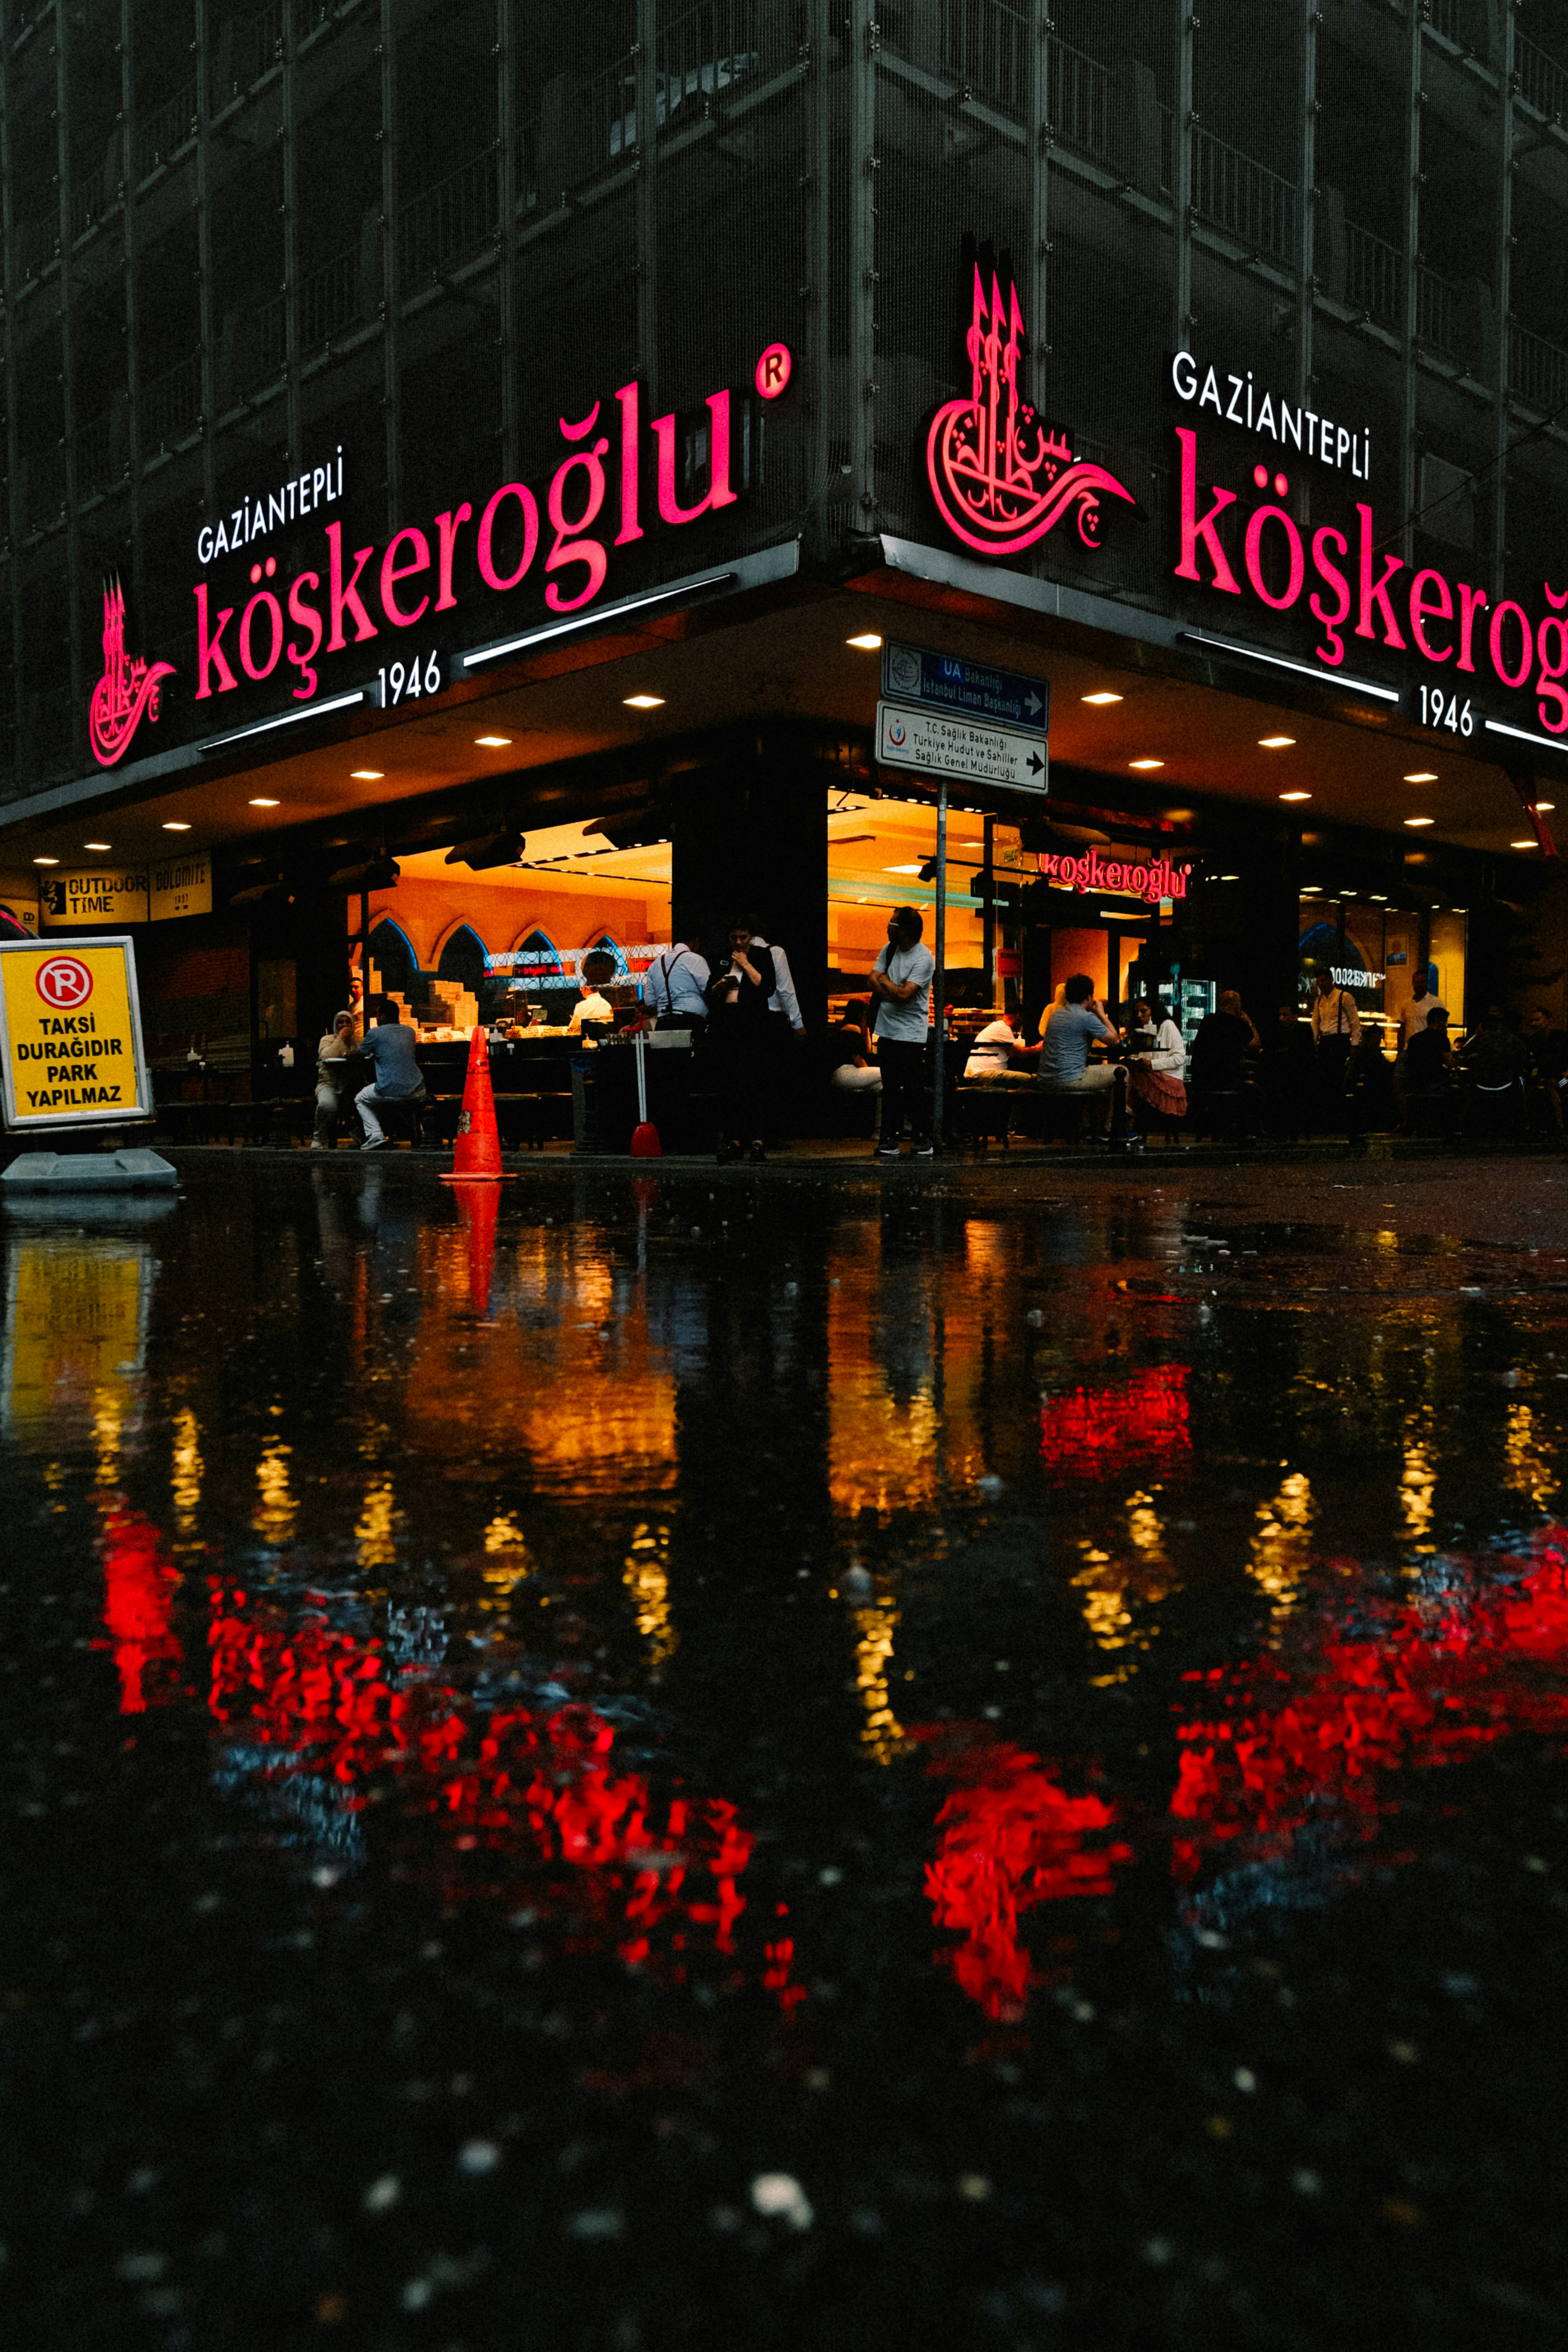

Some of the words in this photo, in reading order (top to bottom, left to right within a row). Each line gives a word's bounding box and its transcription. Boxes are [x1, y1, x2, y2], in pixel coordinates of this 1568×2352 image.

[1173, 351, 1369, 480] GAZİANTEPLİ
[198, 445, 342, 564] GAZİANTEPLİ
[193, 381, 737, 699] köşkeroğlu
[379, 650, 440, 708] 1946
[945, 660, 961, 678] UA
[965, 667, 1002, 694] Bakanlığı
[923, 672, 956, 700] İstanbul
[958, 686, 982, 706] Liman
[983, 692, 1021, 719] Başkanlığı
[1420, 685, 1473, 736] 1946
[914, 733, 945, 752] Türkiye
[948, 741, 973, 755] Hudut
[975, 749, 985, 758] ve
[987, 749, 1018, 765] Sahiller
[926, 722, 939, 734] T.C.
[941, 725, 966, 741] Sağlık
[970, 731, 1007, 750] Bakanlığı
[916, 749, 942, 764] Sağlık
[945, 755, 968, 769] Genel
[970, 760, 1015, 780] Müdürlüğü
[69, 876, 148, 895] OUTDOOR
[69, 896, 114, 914] TIME
[39, 1012, 95, 1035] TAKSİ
[18, 1037, 122, 1060] DURAĞIDIR
[47, 1064, 98, 1083] PARK
[26, 1086, 122, 1107] YAPILMAZ
